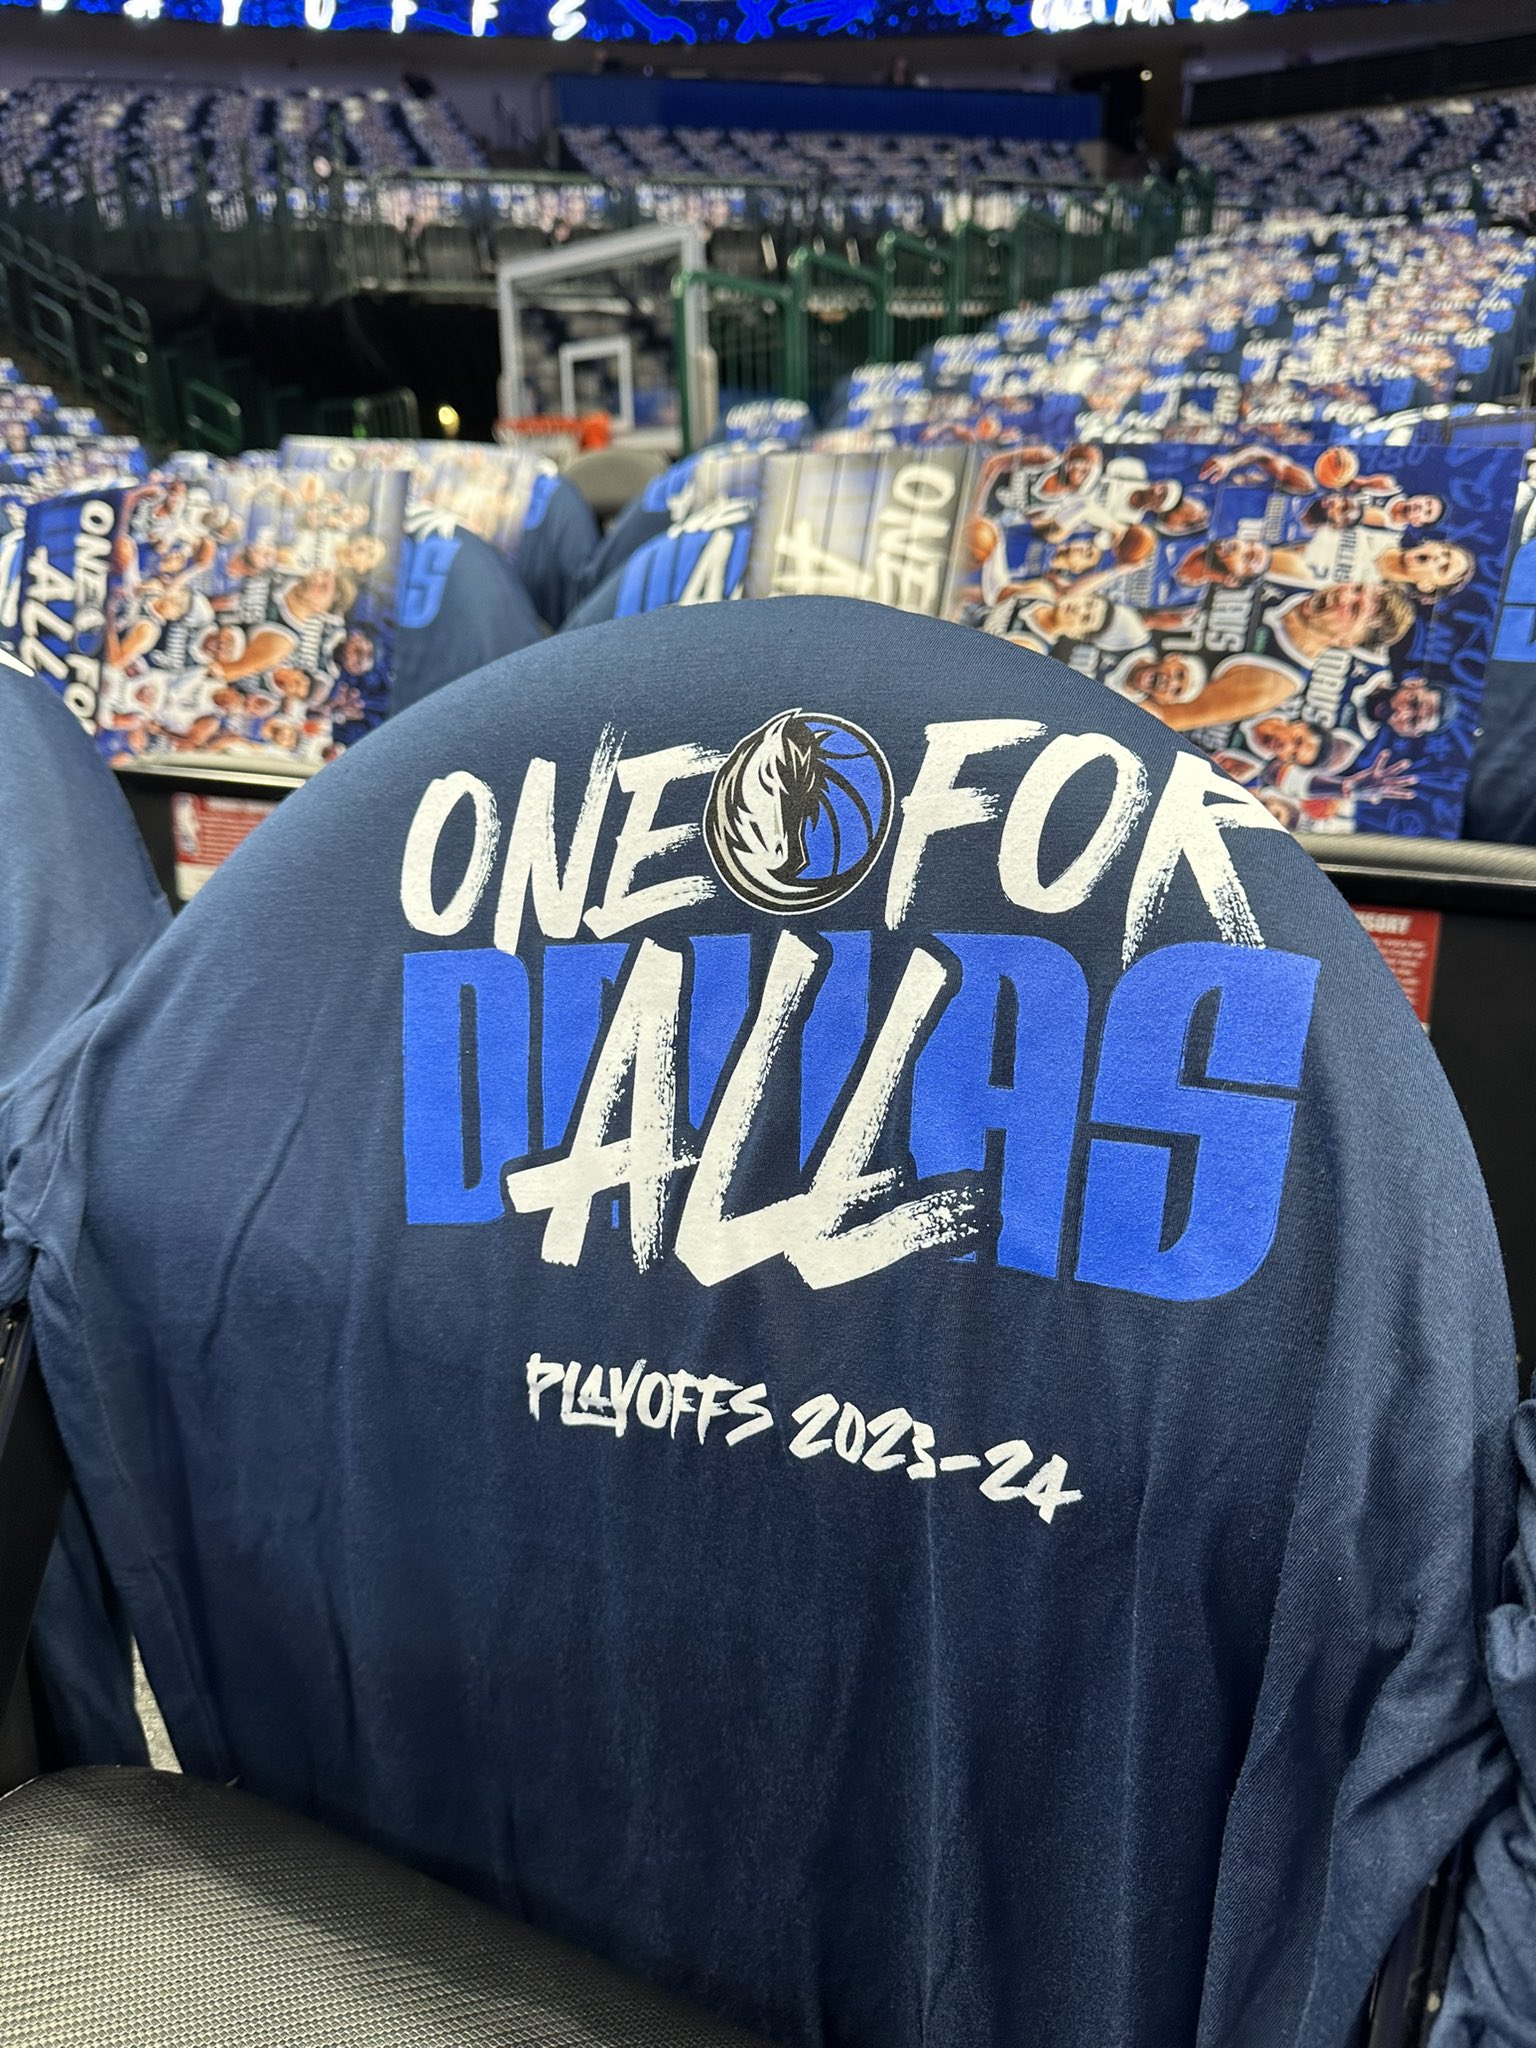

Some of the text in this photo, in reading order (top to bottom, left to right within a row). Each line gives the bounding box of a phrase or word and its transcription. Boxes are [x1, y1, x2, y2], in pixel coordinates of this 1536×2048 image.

[19, 546, 76, 680] ALL
[73, 500, 115, 607] ONE
[401, 719, 1290, 968] ONE FOR
[507, 928, 984, 1290] ALL
[526, 1353, 1083, 1524] PLAYOFFS 2023-24
